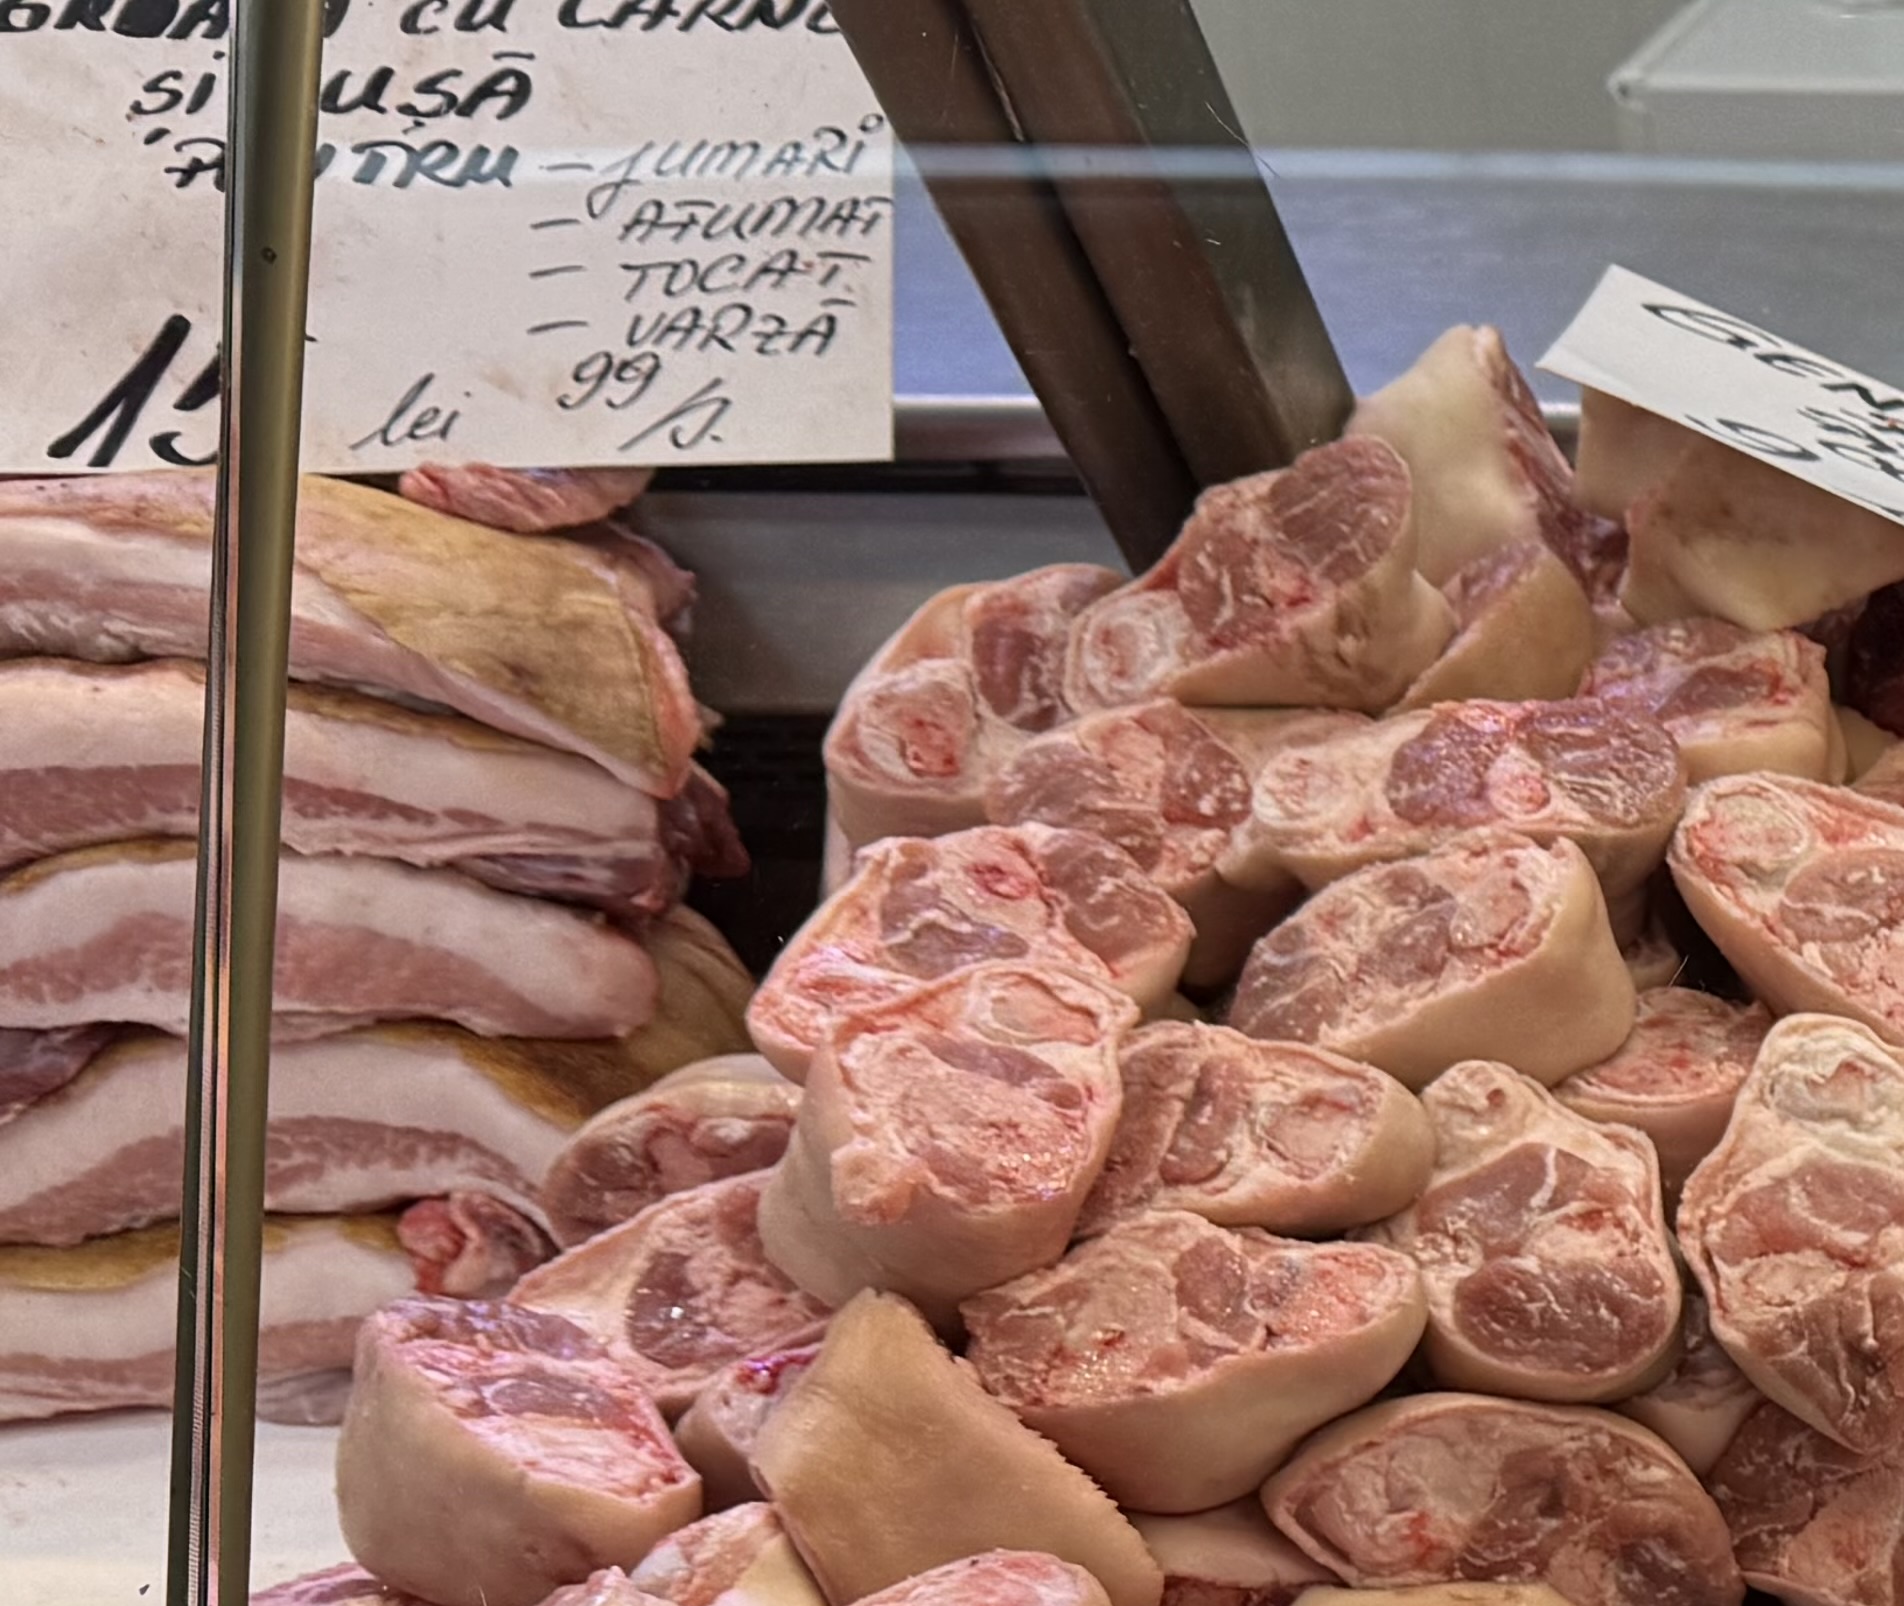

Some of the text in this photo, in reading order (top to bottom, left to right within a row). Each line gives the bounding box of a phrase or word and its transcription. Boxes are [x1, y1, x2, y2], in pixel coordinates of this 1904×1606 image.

[617, 196, 893, 244] AFUMAT
[619, 249, 872, 301] TOCAT
[350, 372, 472, 451] lei
